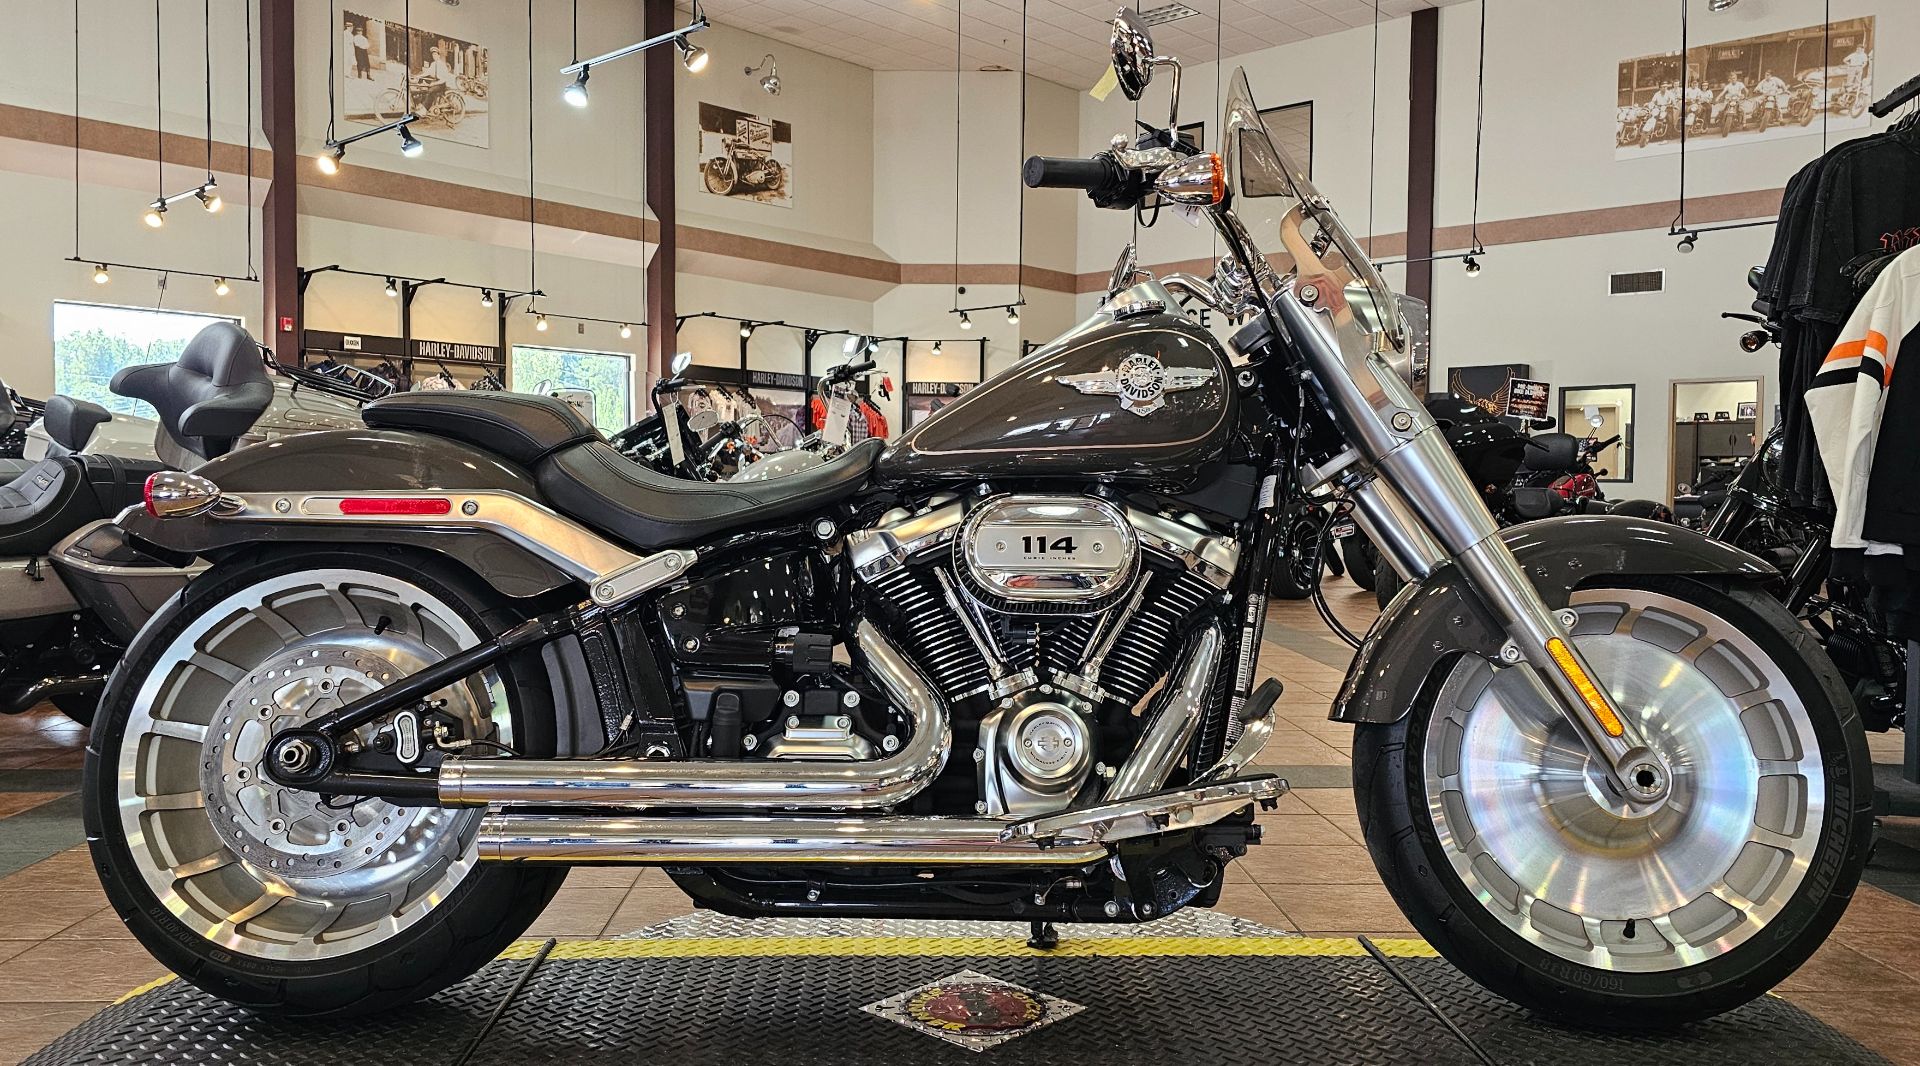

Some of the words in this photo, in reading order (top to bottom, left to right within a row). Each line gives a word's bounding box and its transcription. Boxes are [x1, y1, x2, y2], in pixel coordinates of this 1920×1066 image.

[419, 341, 494, 362] HARLEY-DAVIDSON
[1122, 357, 1160, 374] HARLEY
[752, 371, 804, 387] HARLEY-DAVIDSON
[1120, 376, 1164, 398] DAVIDSON
[1022, 535, 1078, 554] 114
[1804, 784, 1849, 904] MICHELIN
